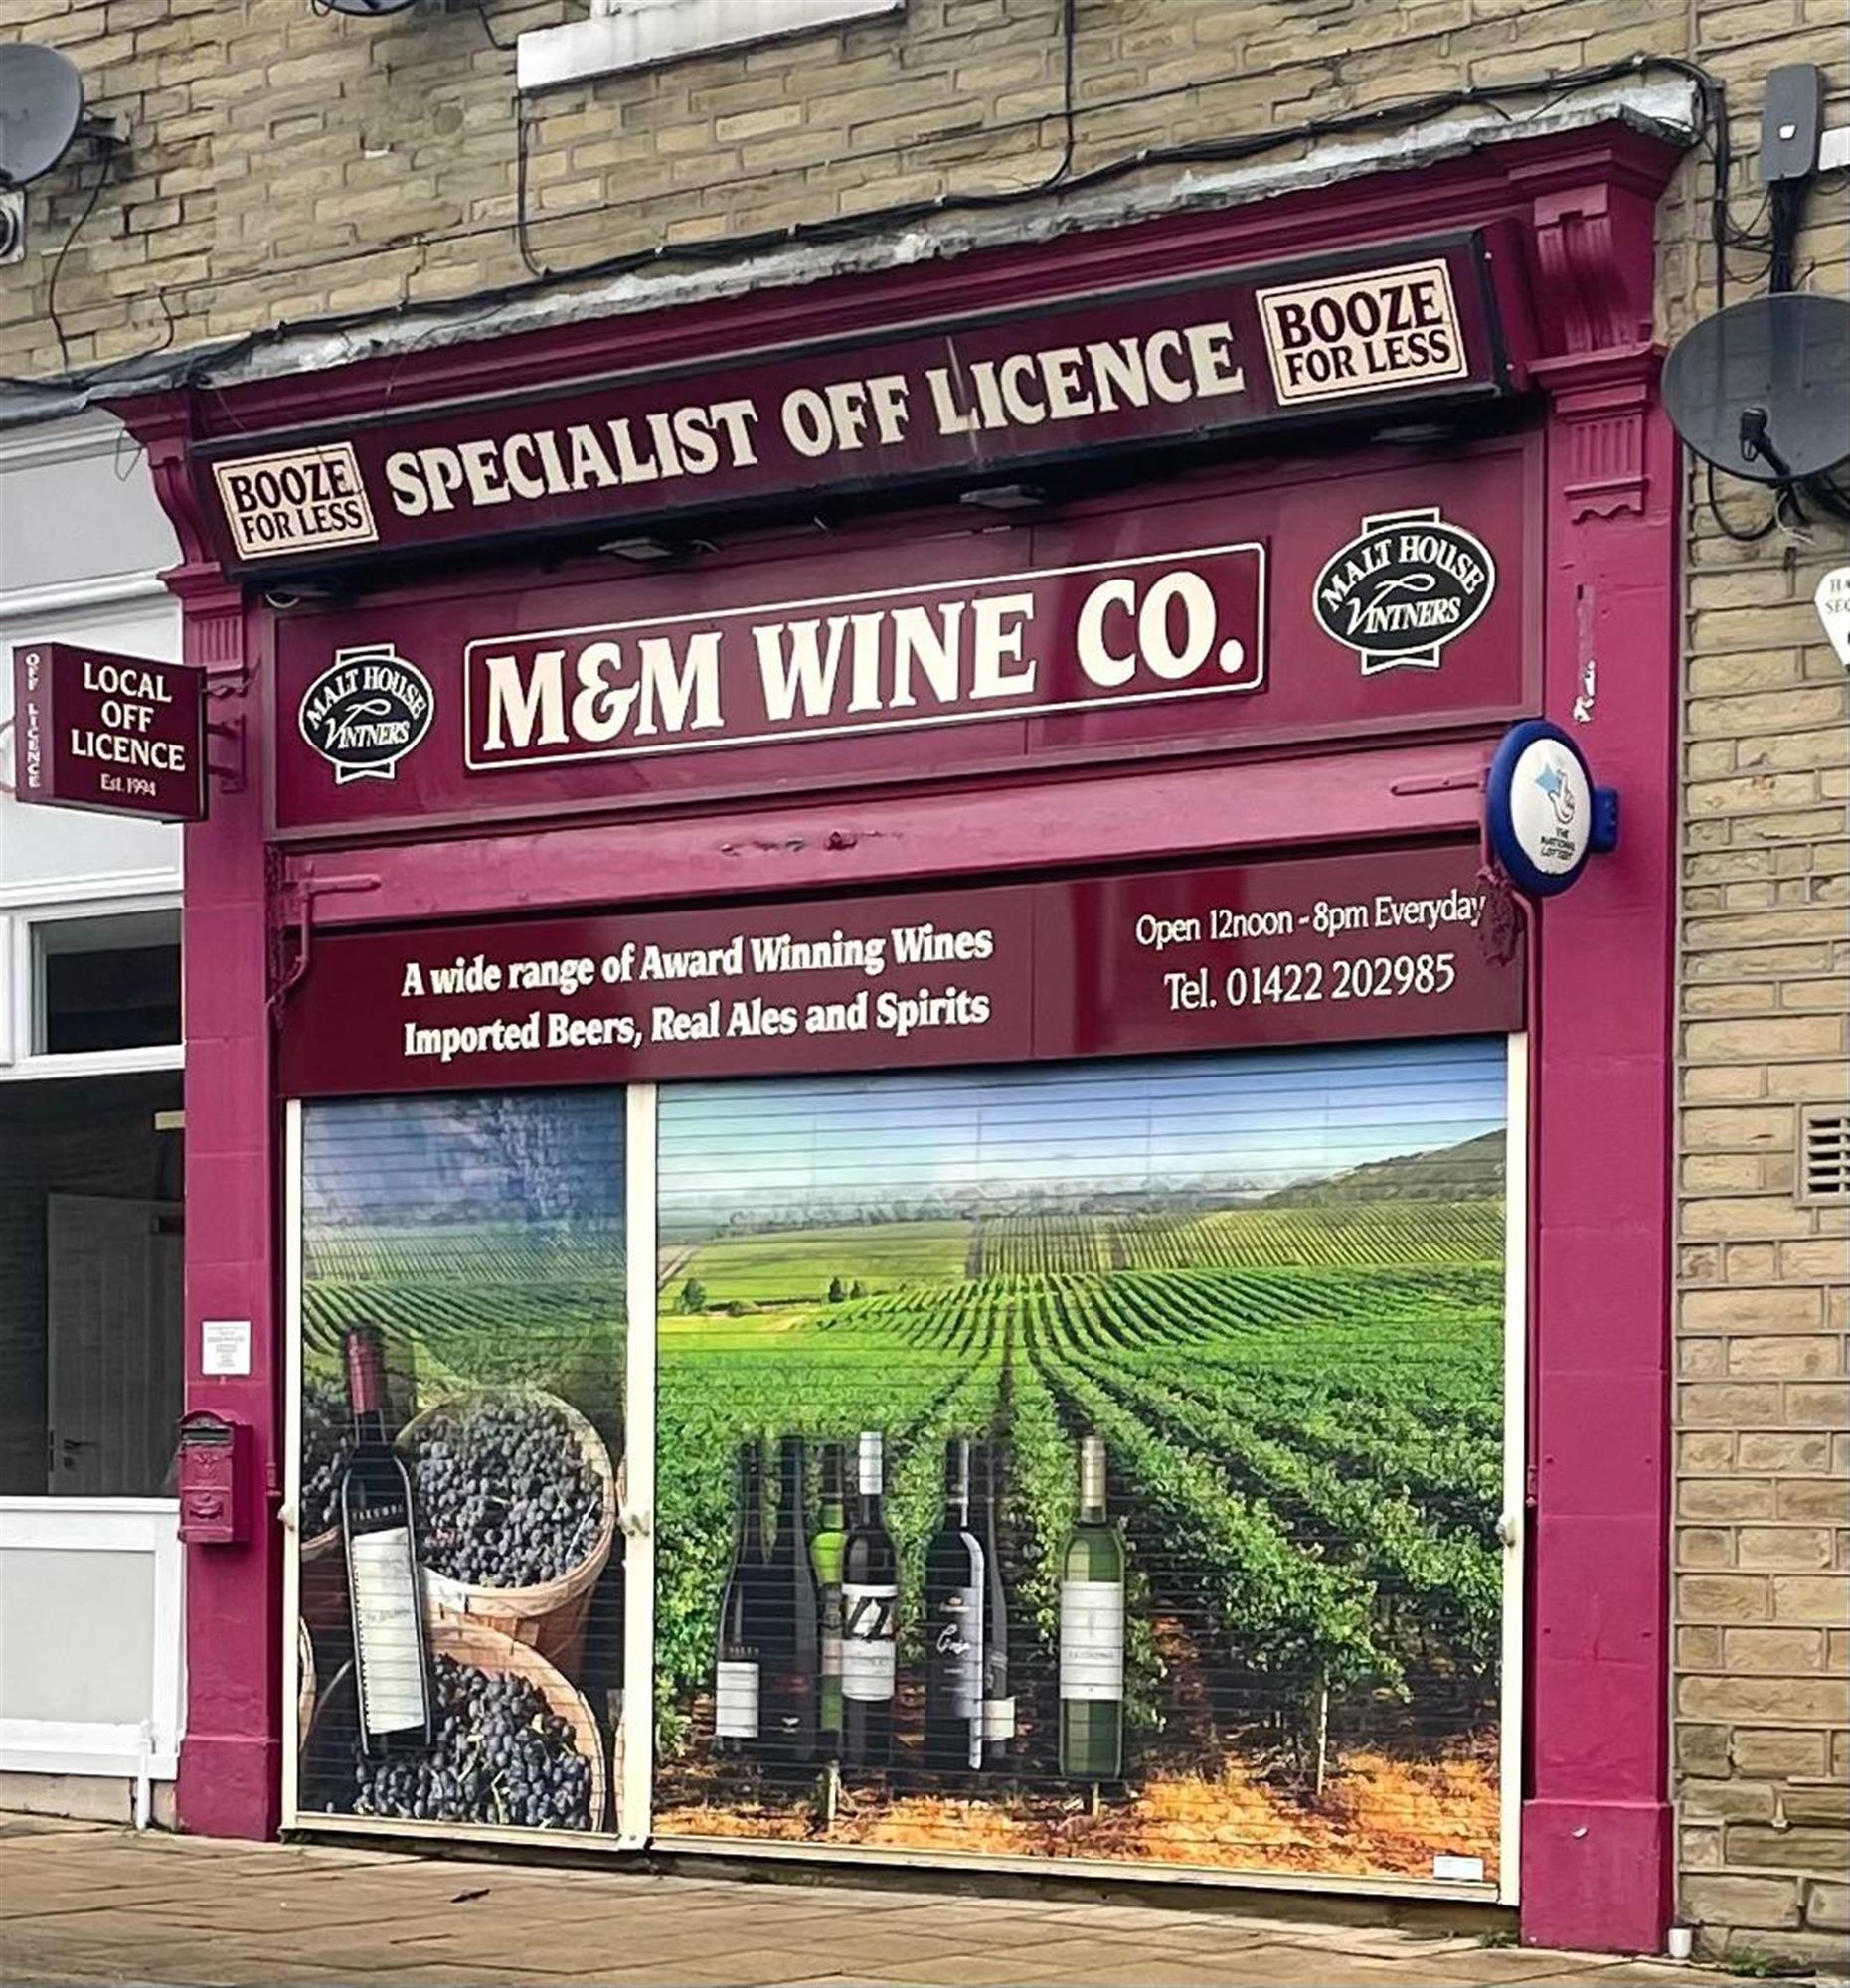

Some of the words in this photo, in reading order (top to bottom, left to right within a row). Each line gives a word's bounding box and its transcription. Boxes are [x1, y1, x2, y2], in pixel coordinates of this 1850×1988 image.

[1273, 281, 1443, 350] BOOZE
[1285, 345, 1354, 386] FOR
[1369, 329, 1451, 373] LESS
[386, 400, 759, 516] SPECIALIST
[781, 375, 909, 456] OFF
[926, 322, 1246, 435] LICENCE
[228, 458, 353, 513] BOOZE
[240, 512, 294, 545] FOR
[298, 503, 363, 536] LESS
[1321, 539, 1392, 612] MALT
[1398, 536, 1485, 595] HOUSE
[1346, 573, 1461, 635] VINTNERS
[25, 653, 40, 691] OFF
[84, 662, 172, 703] LOCAL
[483, 630, 725, 751] M&M
[752, 592, 1036, 723] WINE
[1076, 571, 1245, 688] CO.
[101, 700, 154, 732] OFF
[306, 668, 359, 730] MALT
[363, 666, 427, 720] HOUSE
[324, 698, 410, 750] VINTNERS
[27, 702, 40, 788] LICENCE
[71, 728, 186, 772] LICENCE
[127, 777, 156, 796] 1994
[1136, 914, 1201, 950] Open
[1210, 909, 1293, 940] 12noon
[1313, 902, 1368, 937] 8pm
[1375, 889, 1486, 931] Everyday
[401, 963, 425, 997] A
[430, 955, 501, 994] wide
[508, 958, 594, 995] range
[601, 943, 638, 983] of
[639, 936, 743, 982] Award
[750, 930, 885, 975] Winning
[892, 925, 993, 963] Wines
[1164, 968, 1217, 1010] Tel.
[1226, 962, 1323, 1007] 01422
[1331, 953, 1455, 1000] 202985
[404, 1011, 539, 1060] Imported
[548, 1012, 642, 1049] Beers,
[652, 1000, 719, 1042] Real
[727, 996, 796, 1036] Ales
[805, 991, 868, 1033] and
[877, 986, 990, 1037] Spirits
